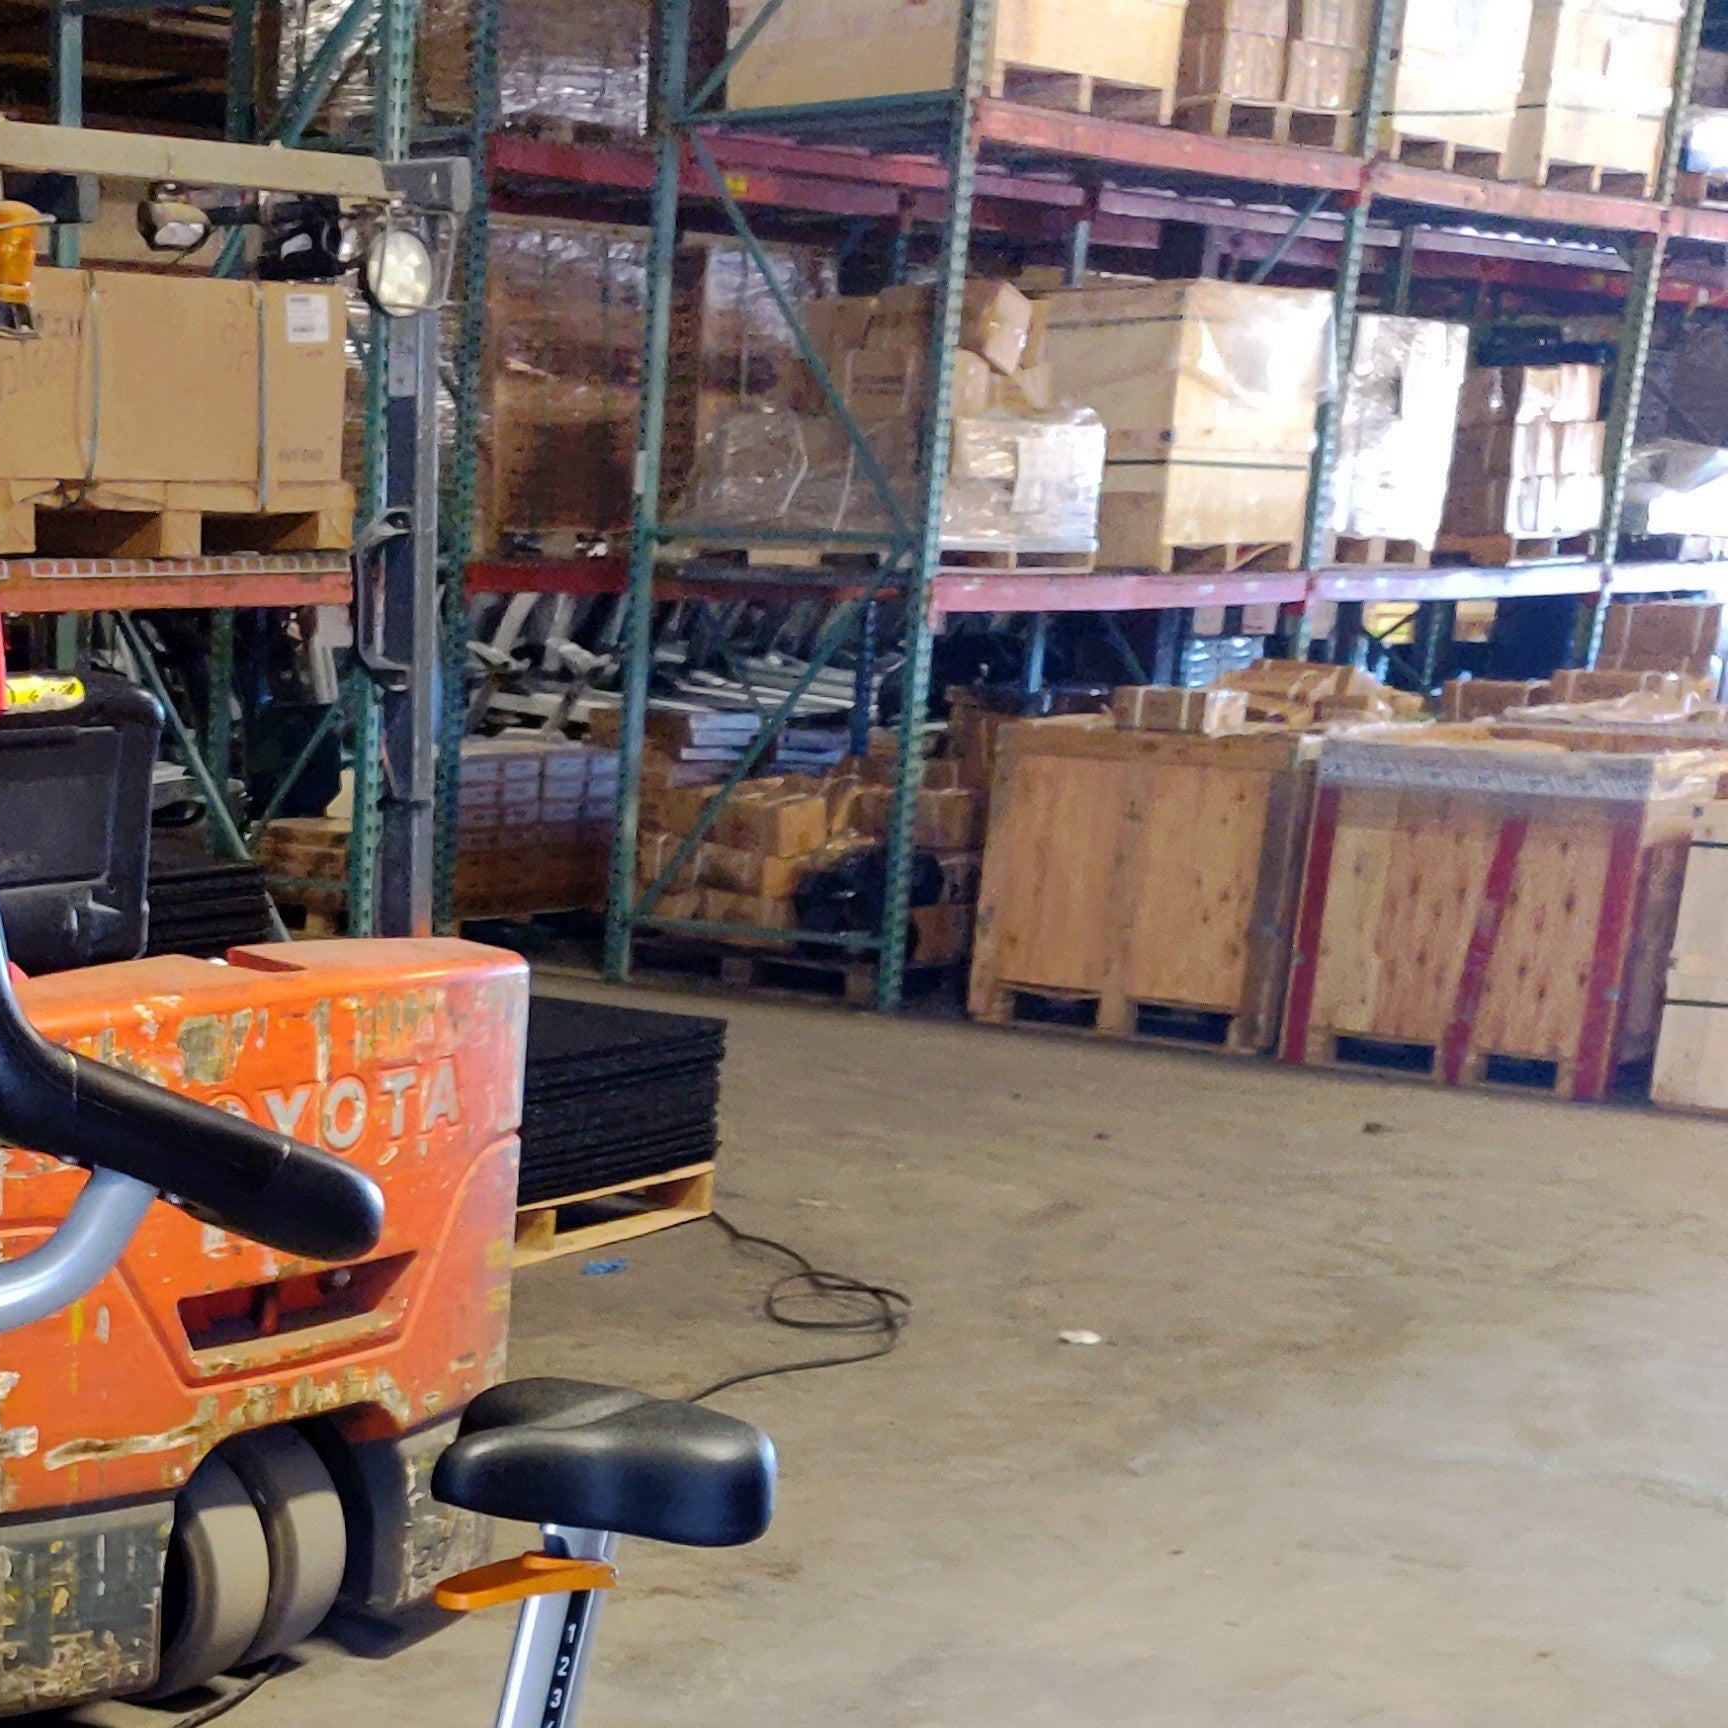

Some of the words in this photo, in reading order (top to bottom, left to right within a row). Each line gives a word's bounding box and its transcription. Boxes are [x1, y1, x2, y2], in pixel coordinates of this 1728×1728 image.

[211, 1056, 460, 1150] YOTA
[567, 1623, 577, 1644] 1
[557, 1656, 570, 1677] 2
[549, 1688, 562, 1709] 3
